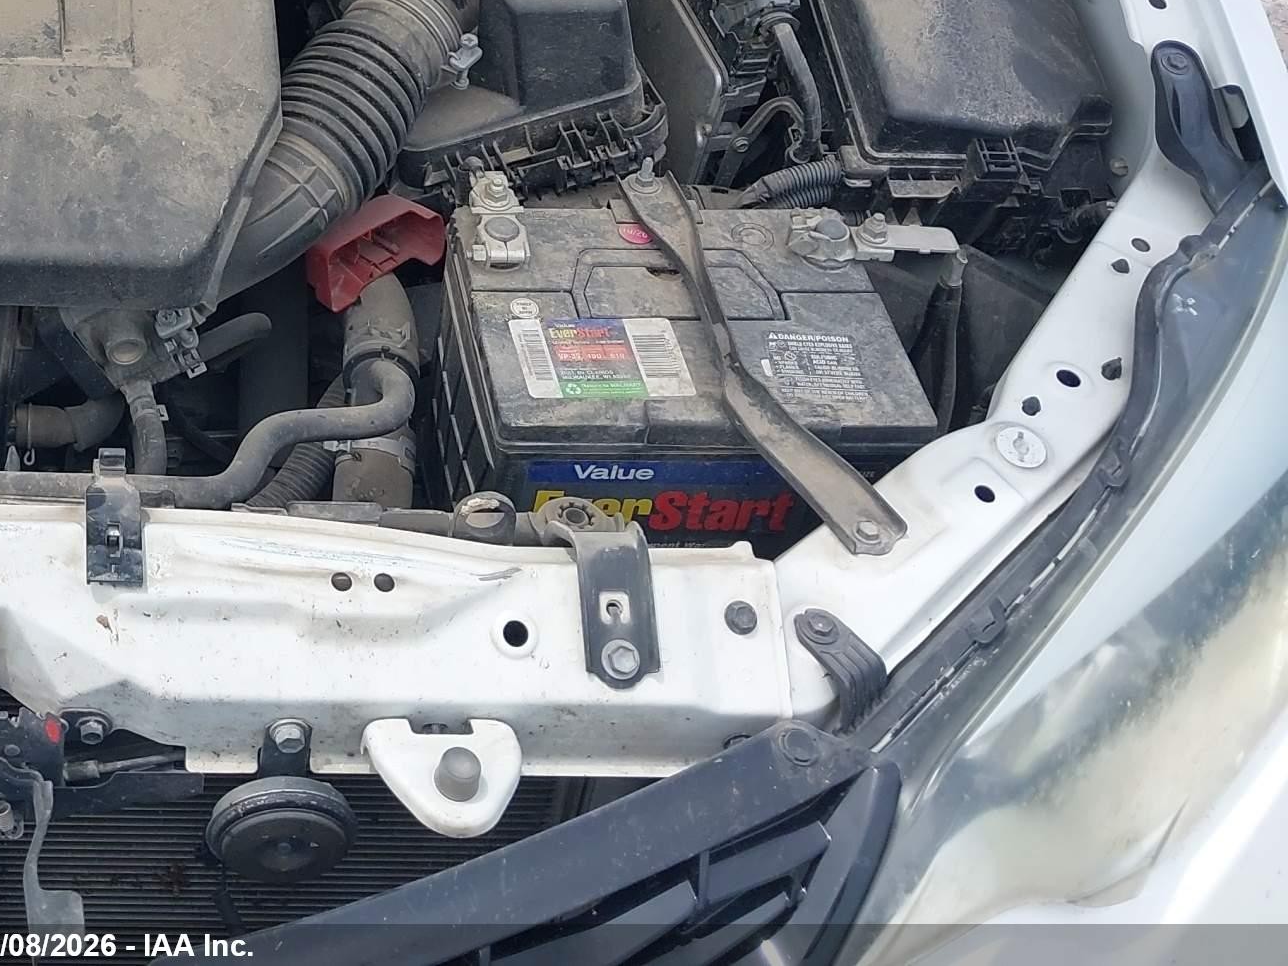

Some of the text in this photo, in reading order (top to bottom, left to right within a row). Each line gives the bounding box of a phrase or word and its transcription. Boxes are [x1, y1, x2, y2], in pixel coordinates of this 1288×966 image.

[549, 327, 611, 338] EverStart
[777, 334, 850, 342] DANGER/POISON
[573, 464, 656, 481] Value
